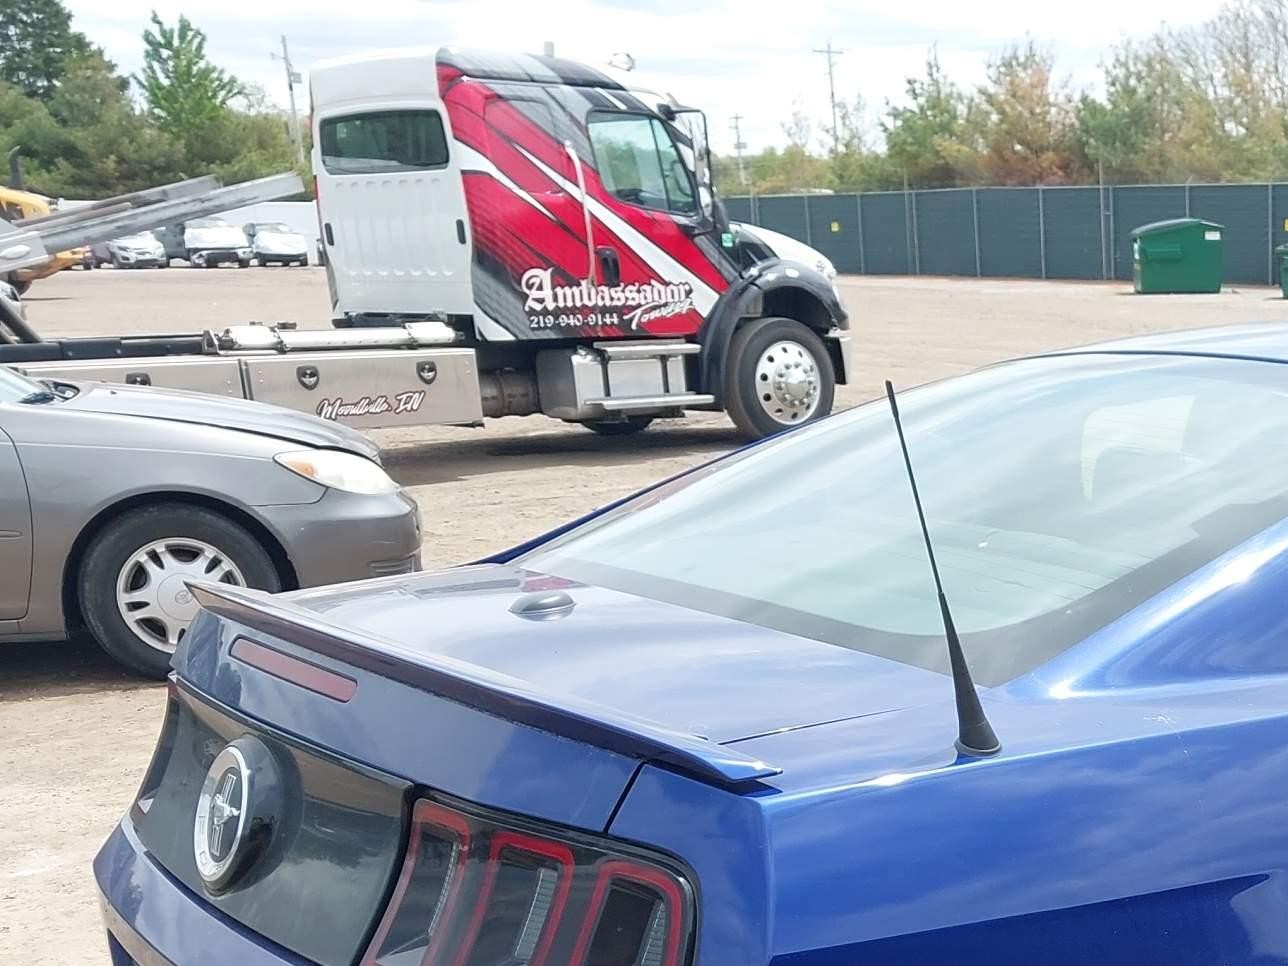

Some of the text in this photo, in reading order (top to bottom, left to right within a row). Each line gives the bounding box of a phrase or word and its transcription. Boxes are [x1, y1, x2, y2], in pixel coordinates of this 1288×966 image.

[521, 267, 694, 312] Ambassador
[529, 313, 619, 329] 219-940-9144
[395, 390, 425, 414] IN
